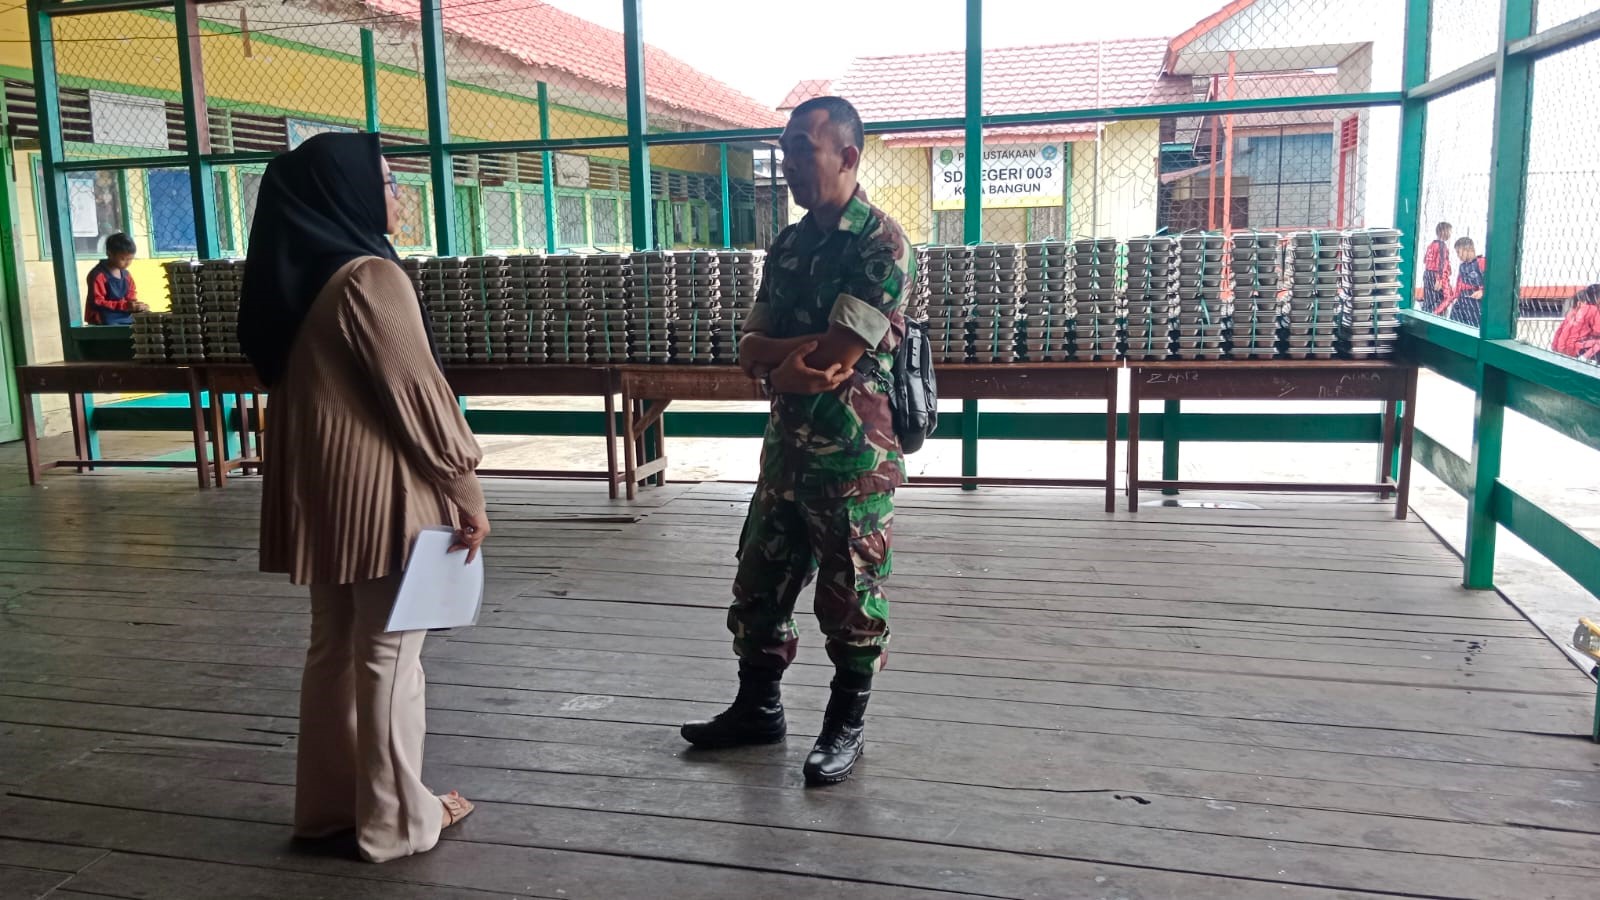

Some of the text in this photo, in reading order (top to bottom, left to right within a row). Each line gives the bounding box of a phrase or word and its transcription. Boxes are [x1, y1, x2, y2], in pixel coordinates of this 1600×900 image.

[958, 149, 1036, 161] PUSTAKAAN
[943, 166, 1052, 183] SD EGERI 003
[989, 182, 1041, 195] BANGUN
